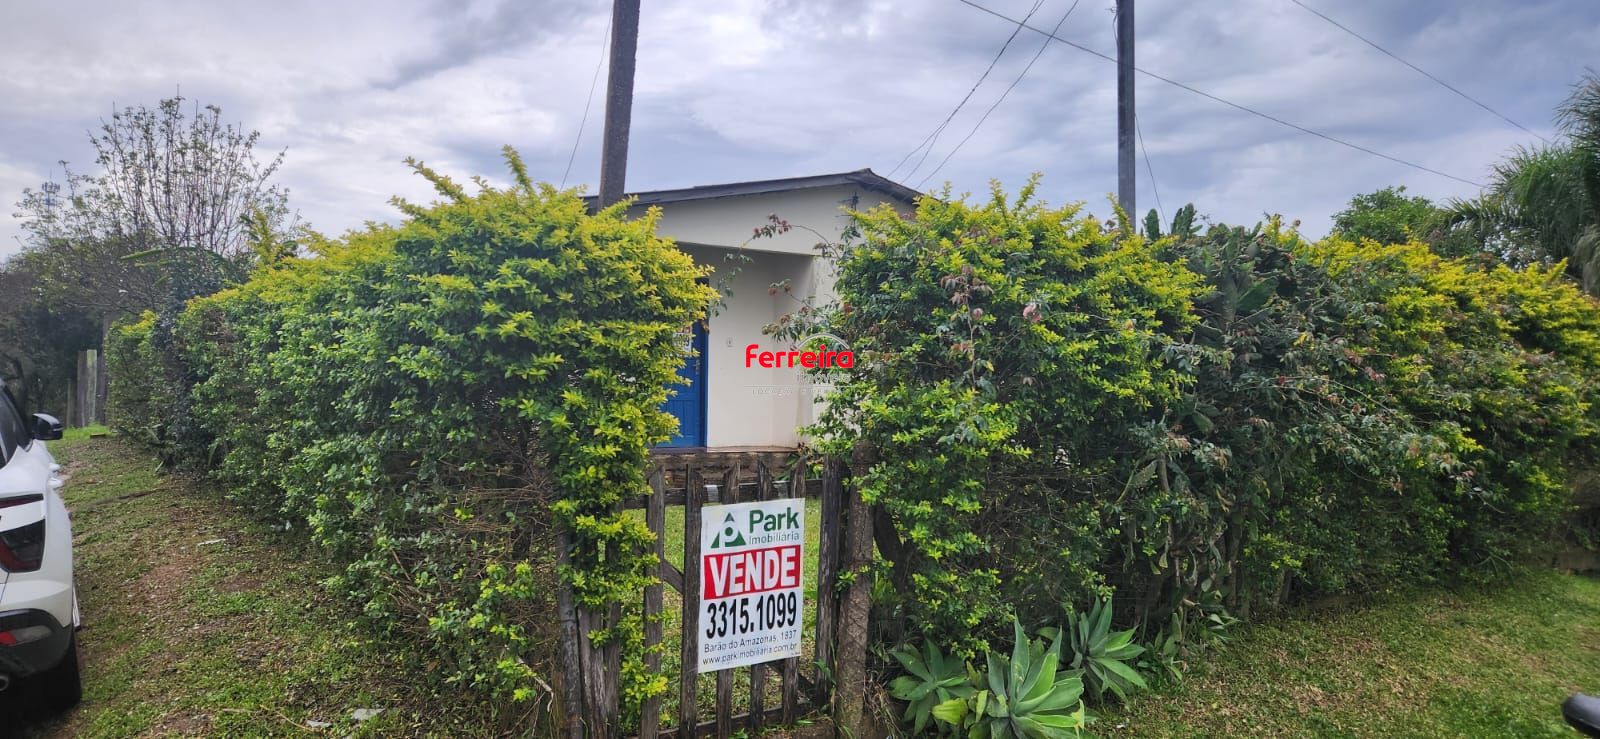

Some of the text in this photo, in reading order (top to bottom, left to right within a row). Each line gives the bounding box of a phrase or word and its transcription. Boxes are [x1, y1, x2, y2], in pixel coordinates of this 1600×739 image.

[749, 507, 799, 534] Park
[709, 547, 796, 597] VENDE
[706, 592, 797, 639] 3315.1099
[704, 642, 727, 653] Barão
[728, 638, 738, 649] do
